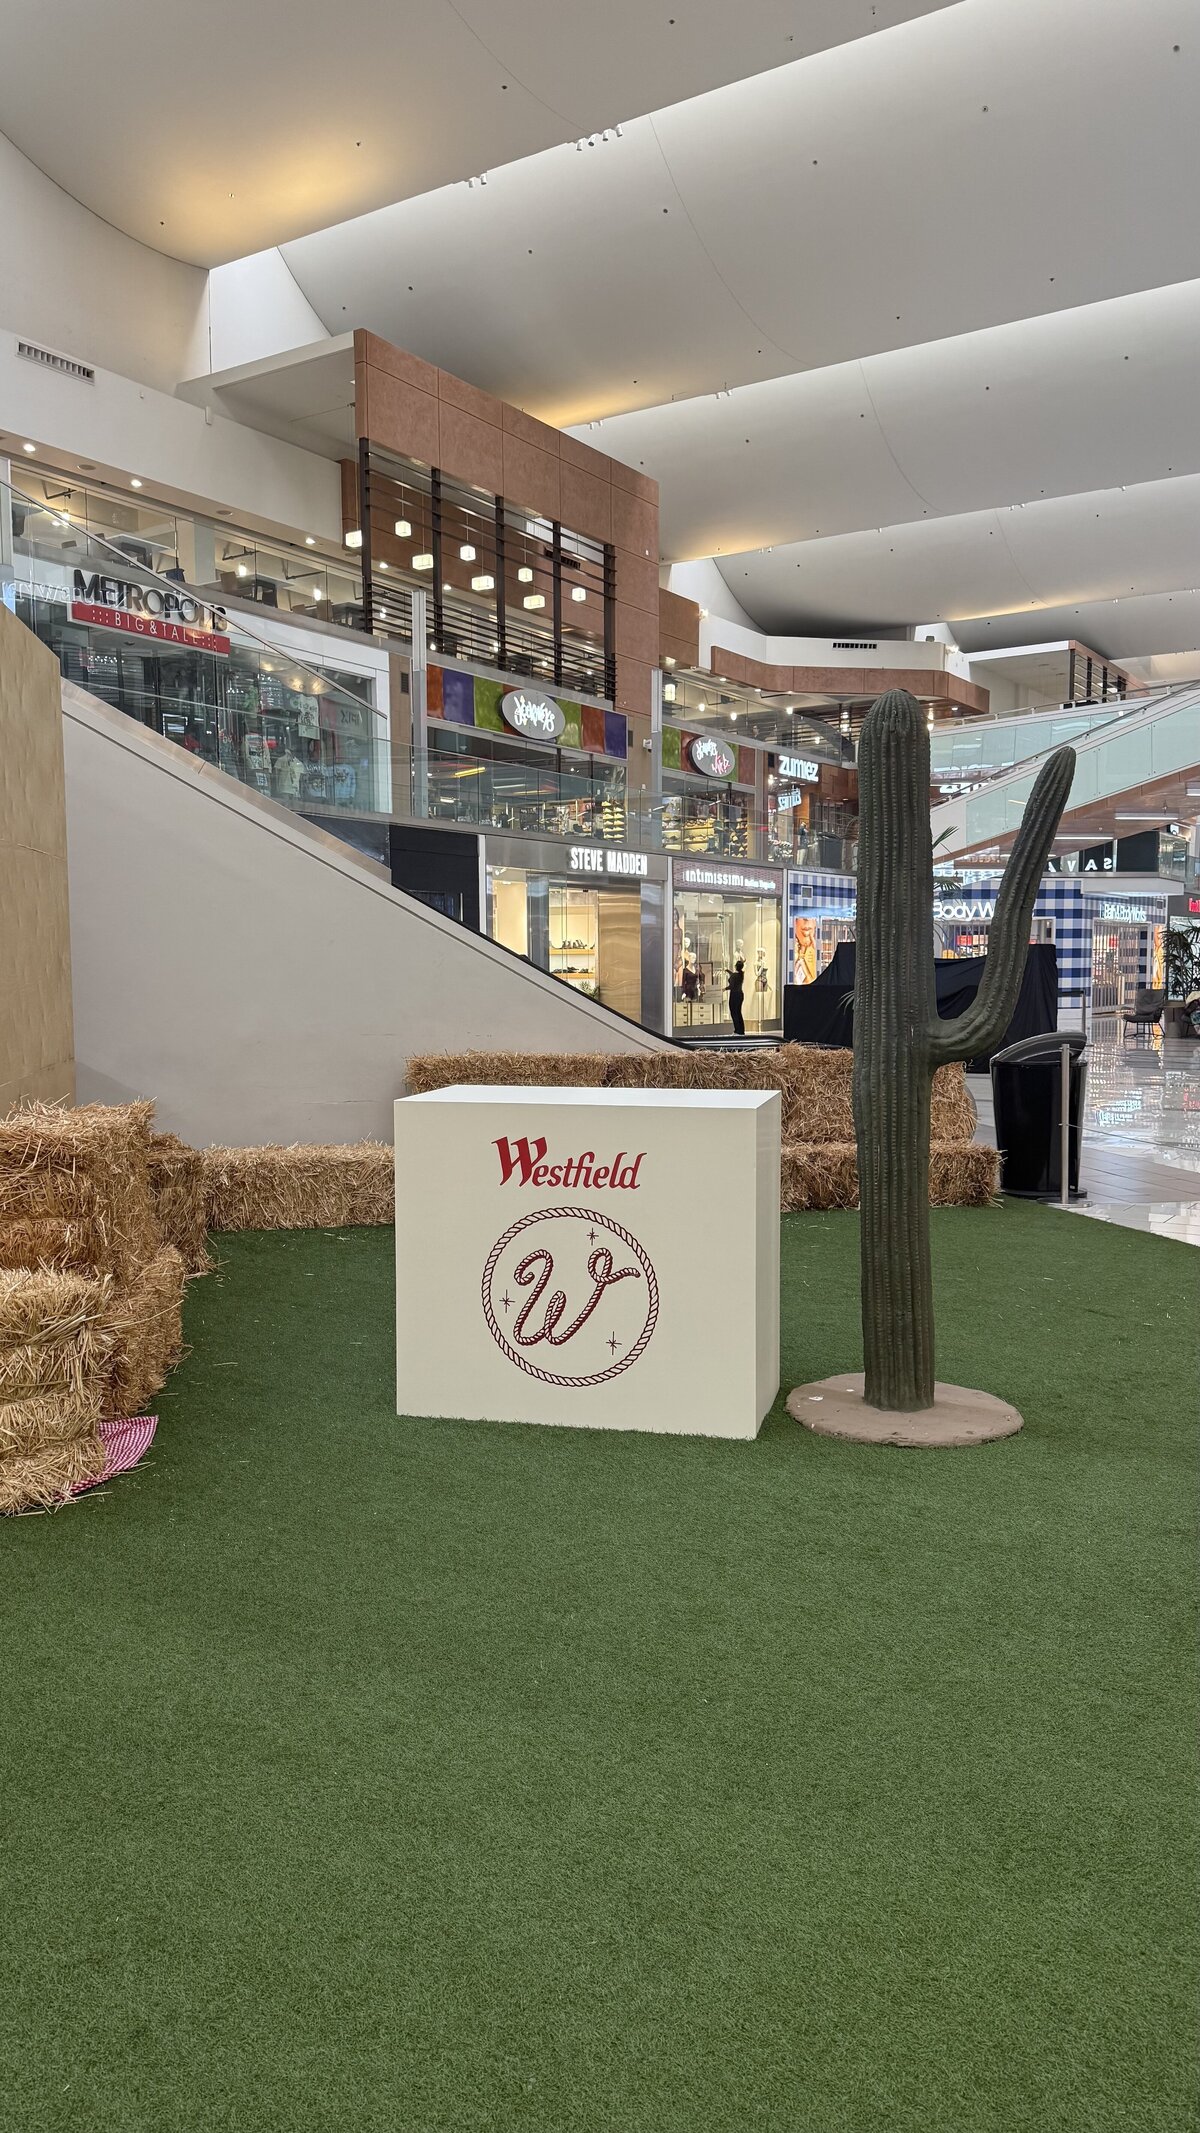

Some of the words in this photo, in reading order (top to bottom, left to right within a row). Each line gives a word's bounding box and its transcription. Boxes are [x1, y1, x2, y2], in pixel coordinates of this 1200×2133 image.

[73, 569, 228, 632] METROPOLIS
[570, 847, 603, 872] STEVE
[607, 851, 648, 876] MADDEN
[933, 901, 977, 922] Body
[491, 1136, 648, 1190] Westfield
